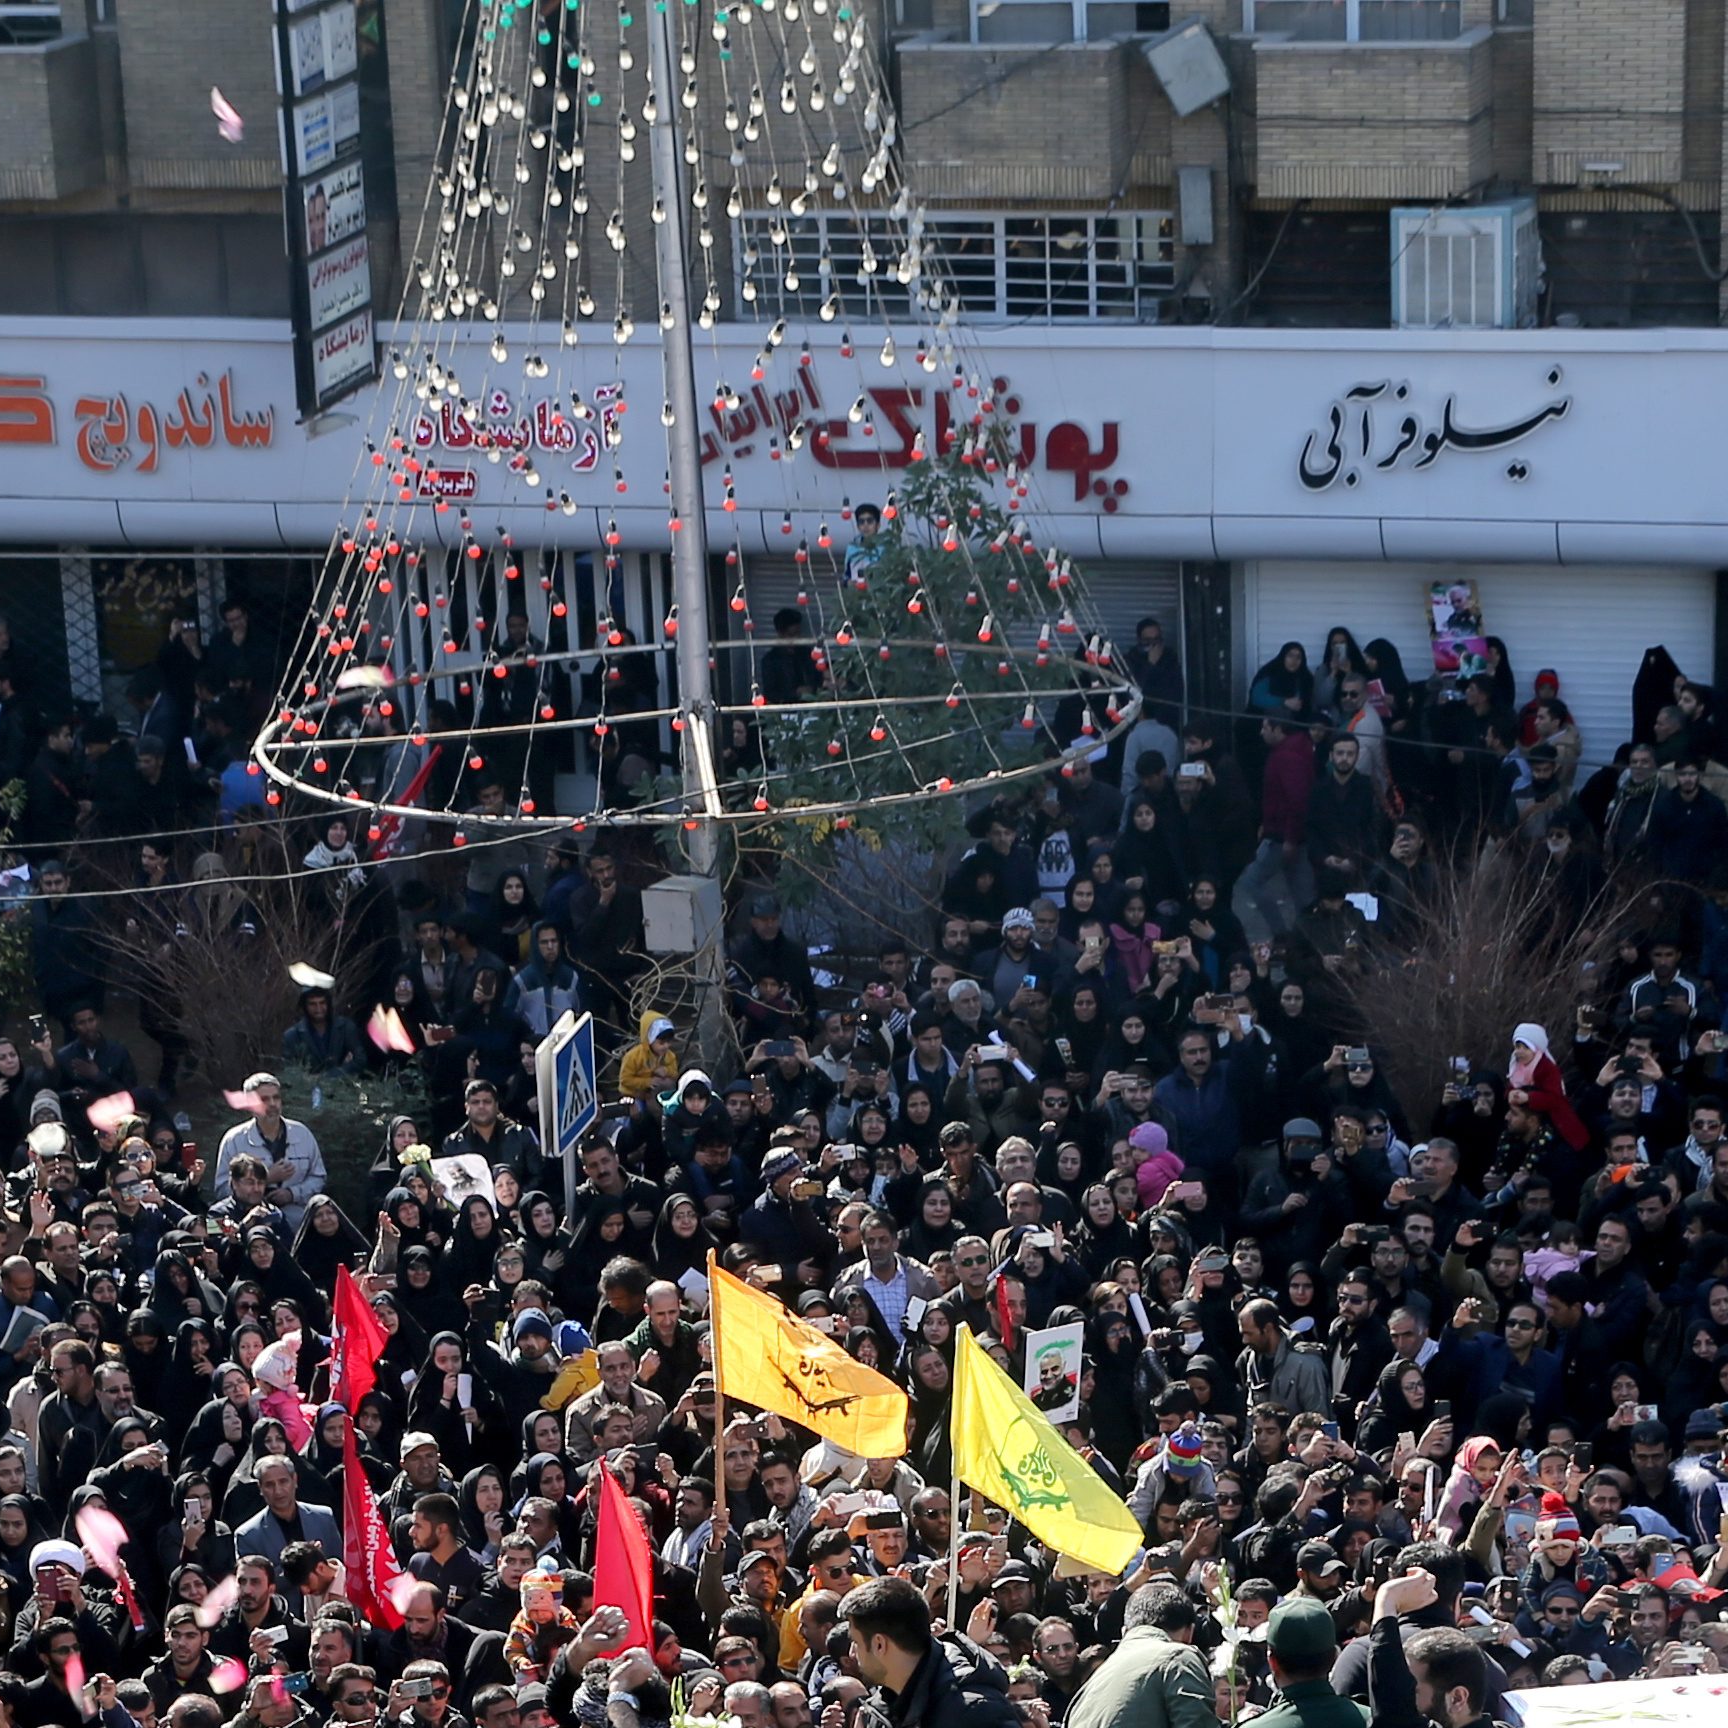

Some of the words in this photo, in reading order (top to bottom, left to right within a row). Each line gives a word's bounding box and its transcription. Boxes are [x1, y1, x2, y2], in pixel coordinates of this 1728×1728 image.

[319, 312, 369, 362] آزمایشگاه
[74, 367, 275, 473] ساندویچ
[411, 380, 625, 473] آزمایشگاه
[810, 375, 1119, 513] پوشاک
[1299, 377, 1389, 491] آبی
[1377, 363, 1573, 483] نیلوفر
